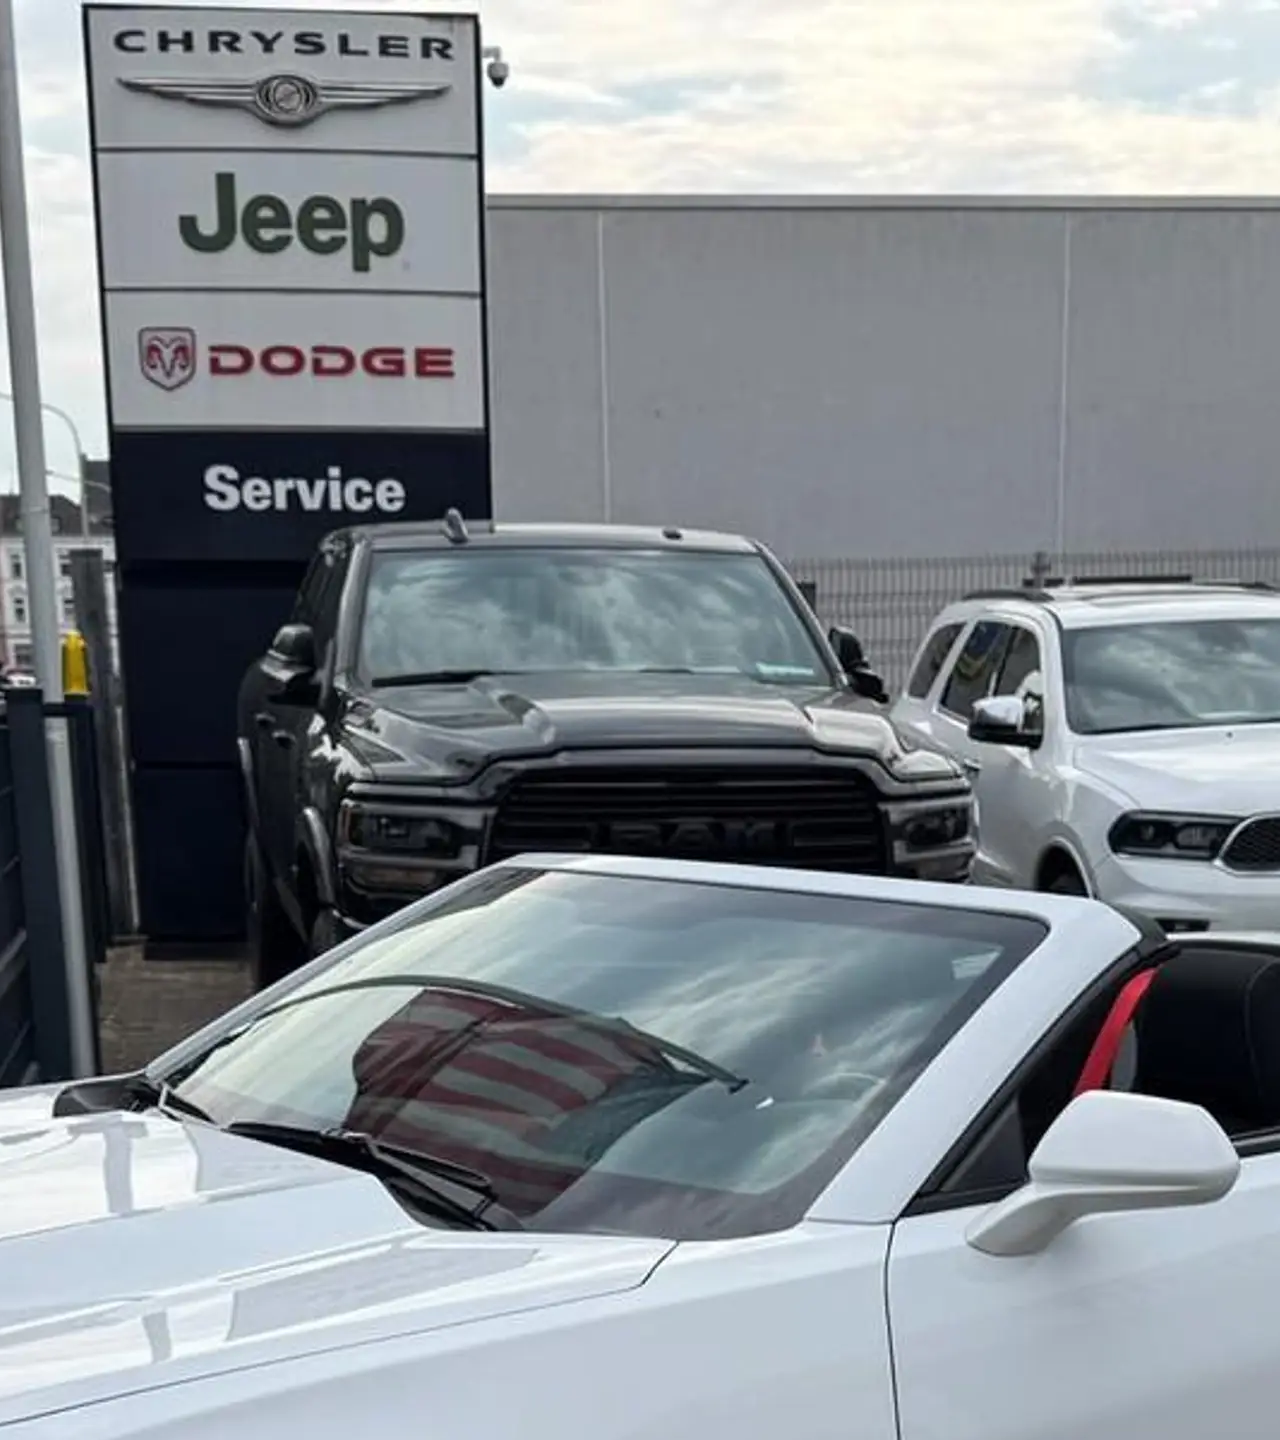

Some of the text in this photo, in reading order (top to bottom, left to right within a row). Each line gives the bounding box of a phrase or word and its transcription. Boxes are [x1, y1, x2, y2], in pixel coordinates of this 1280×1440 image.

[113, 29, 455, 61] CHRYSLER
[178, 171, 405, 273] Jeep
[208, 344, 456, 378] DODGE
[204, 464, 407, 513] Service
[608, 819, 777, 858] RAM
